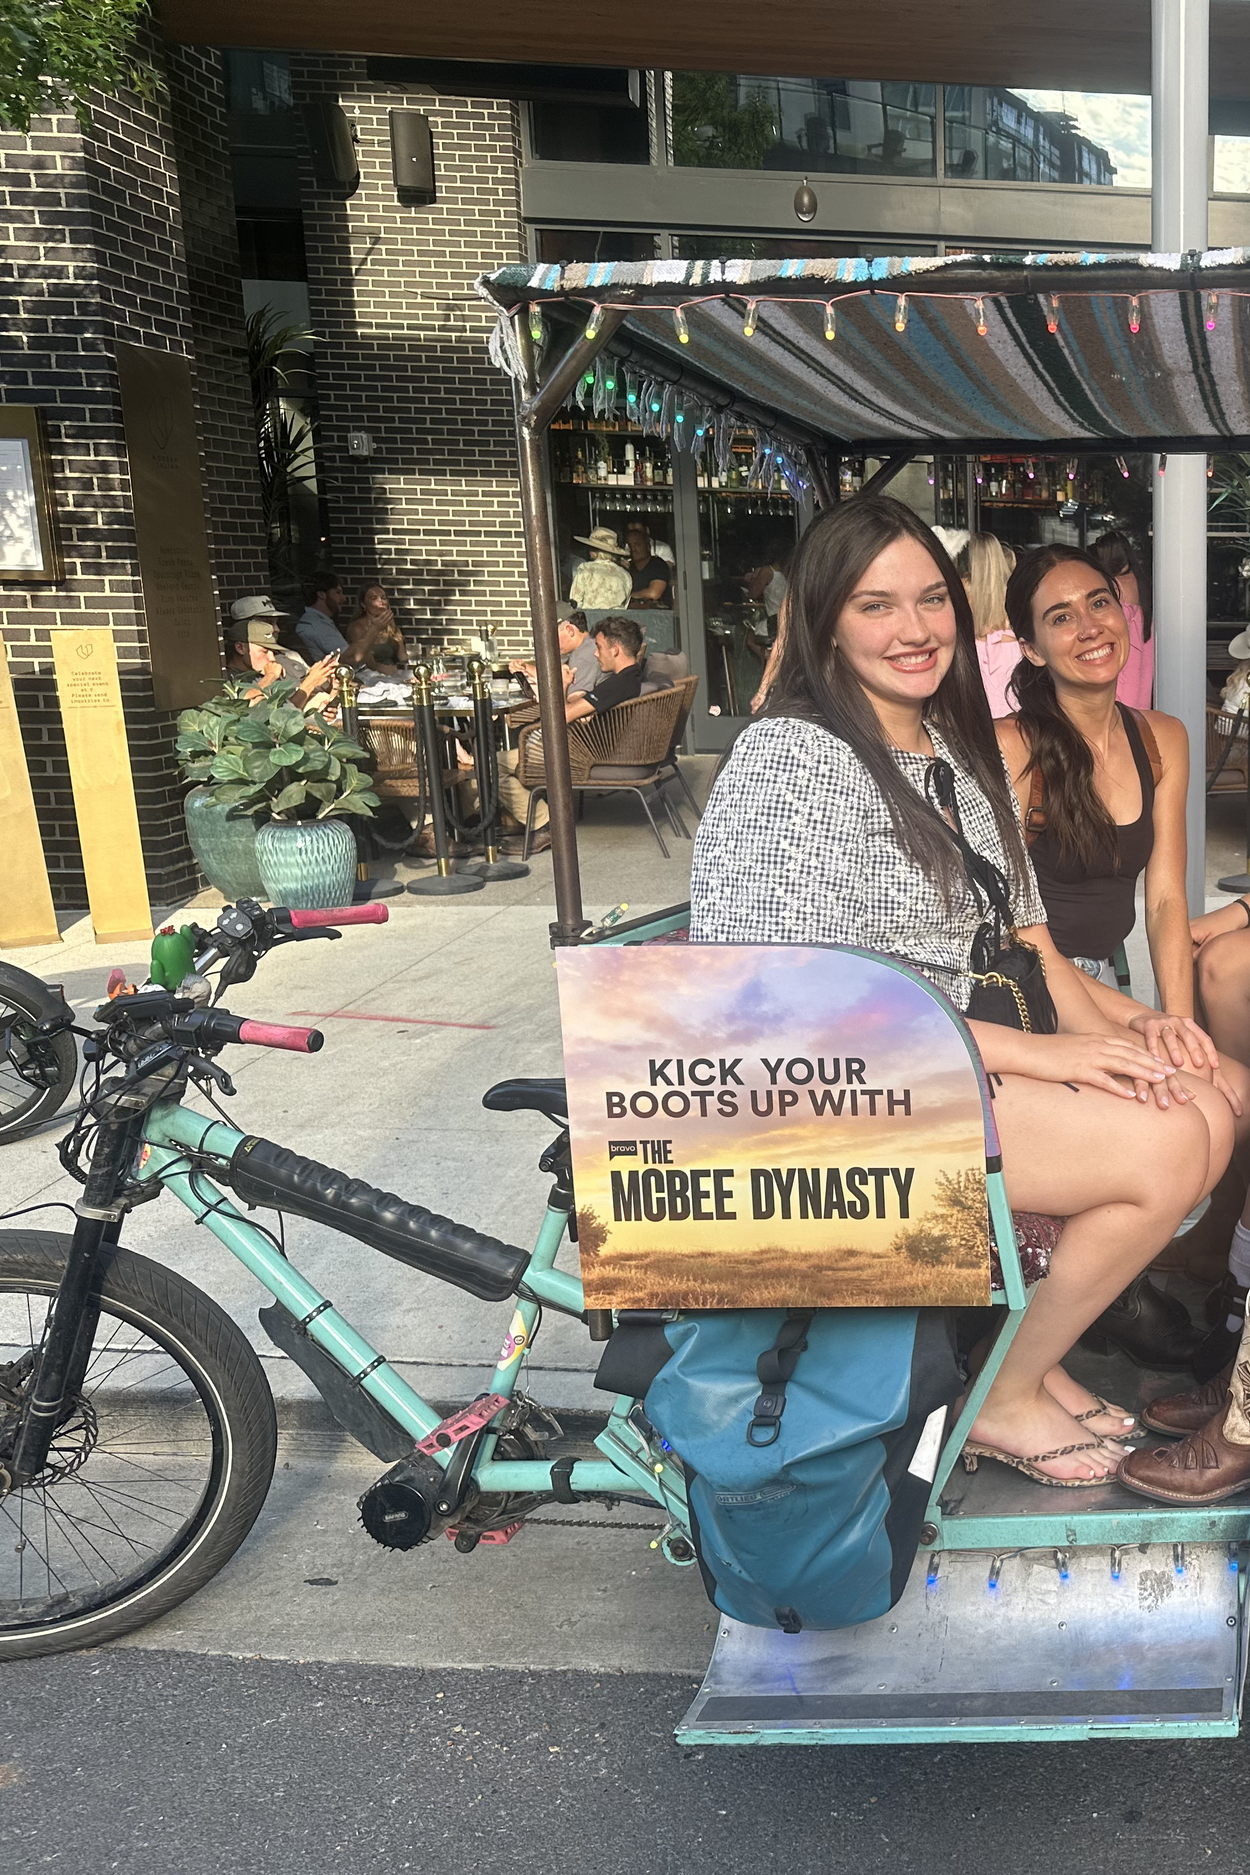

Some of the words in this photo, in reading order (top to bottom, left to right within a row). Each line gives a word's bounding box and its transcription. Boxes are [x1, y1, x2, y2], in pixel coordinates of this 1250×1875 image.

[649, 1058, 745, 1086] KICK
[760, 1057, 866, 1085] YOUR
[606, 1090, 739, 1118] BOOTS
[750, 1090, 799, 1117] UP
[809, 1089, 912, 1117] WITH
[610, 1144, 636, 1152] bravo
[639, 1140, 674, 1164] THE
[610, 1168, 737, 1222] MCBEE
[751, 1167, 915, 1220] DYNASTY
